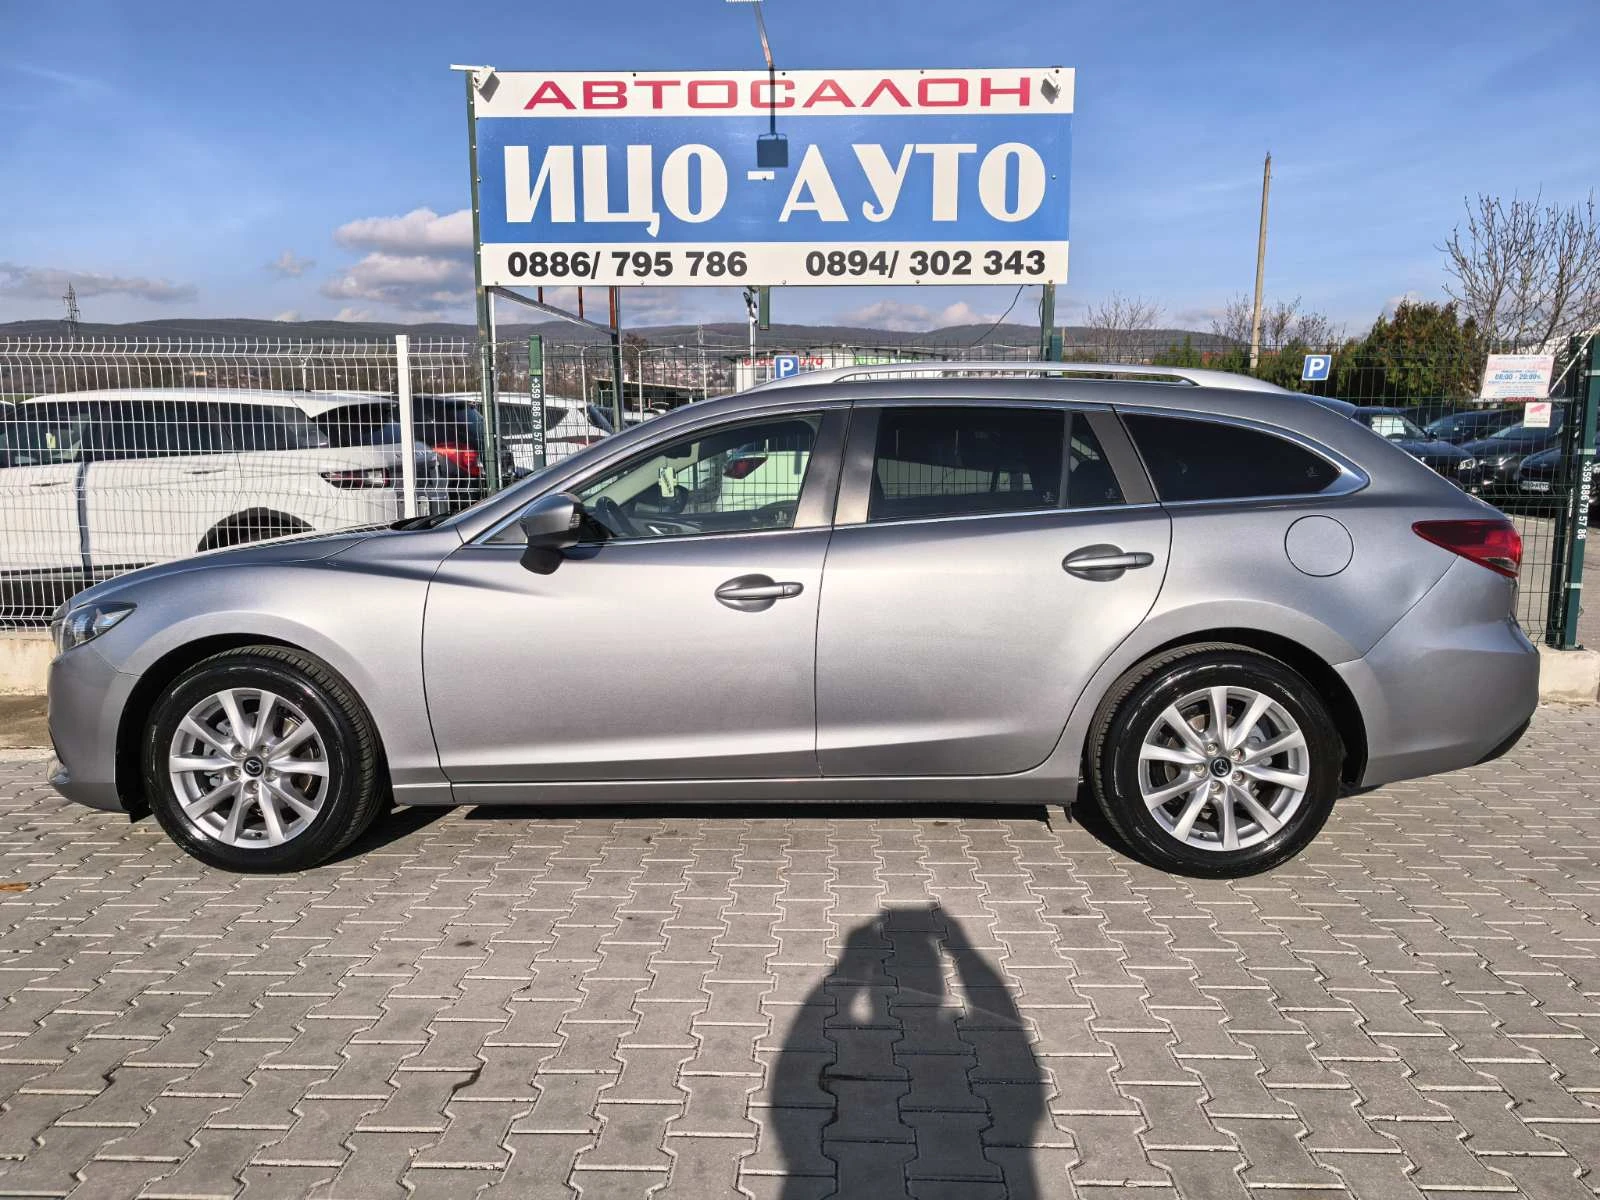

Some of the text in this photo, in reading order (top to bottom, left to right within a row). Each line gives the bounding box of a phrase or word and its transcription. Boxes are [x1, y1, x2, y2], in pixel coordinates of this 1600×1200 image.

[523, 77, 1031, 110] АВТОСАЛОН
[507, 251, 748, 279] 0886/ 795 786
[805, 250, 1046, 278] 0894/ 302 343
[780, 359, 794, 377] P
[1308, 358, 1325, 377] P
[532, 378, 543, 454] +359 886 79 57 86
[1577, 461, 1592, 539] +359 886 79 57 86
